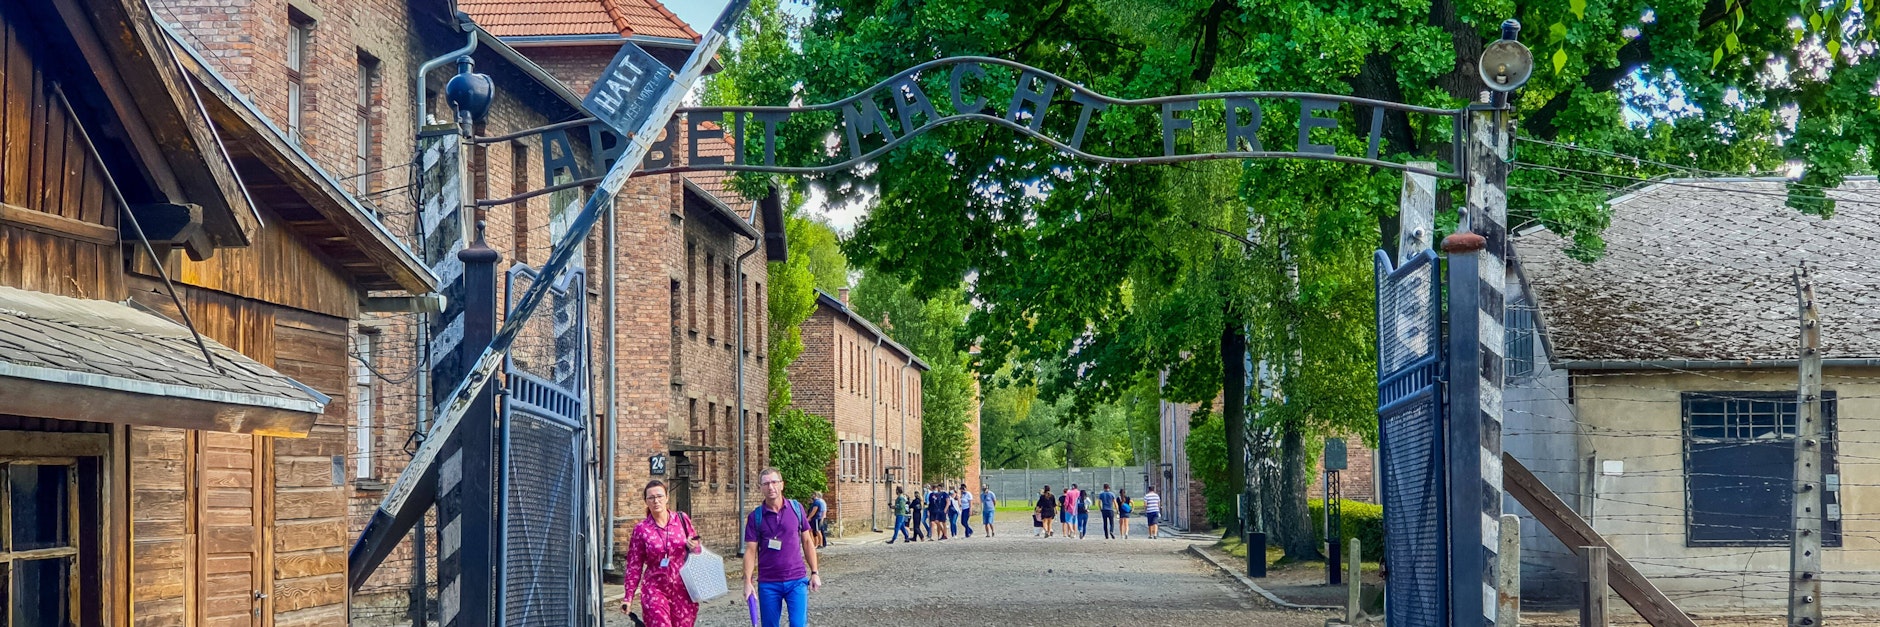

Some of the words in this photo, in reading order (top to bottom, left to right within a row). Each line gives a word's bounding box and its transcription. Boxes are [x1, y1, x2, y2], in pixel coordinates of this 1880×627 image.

[542, 111, 792, 187] ARBEIT
[842, 62, 1108, 157] MACHT
[1162, 98, 1385, 160] FREI
[593, 54, 644, 114] HALT
